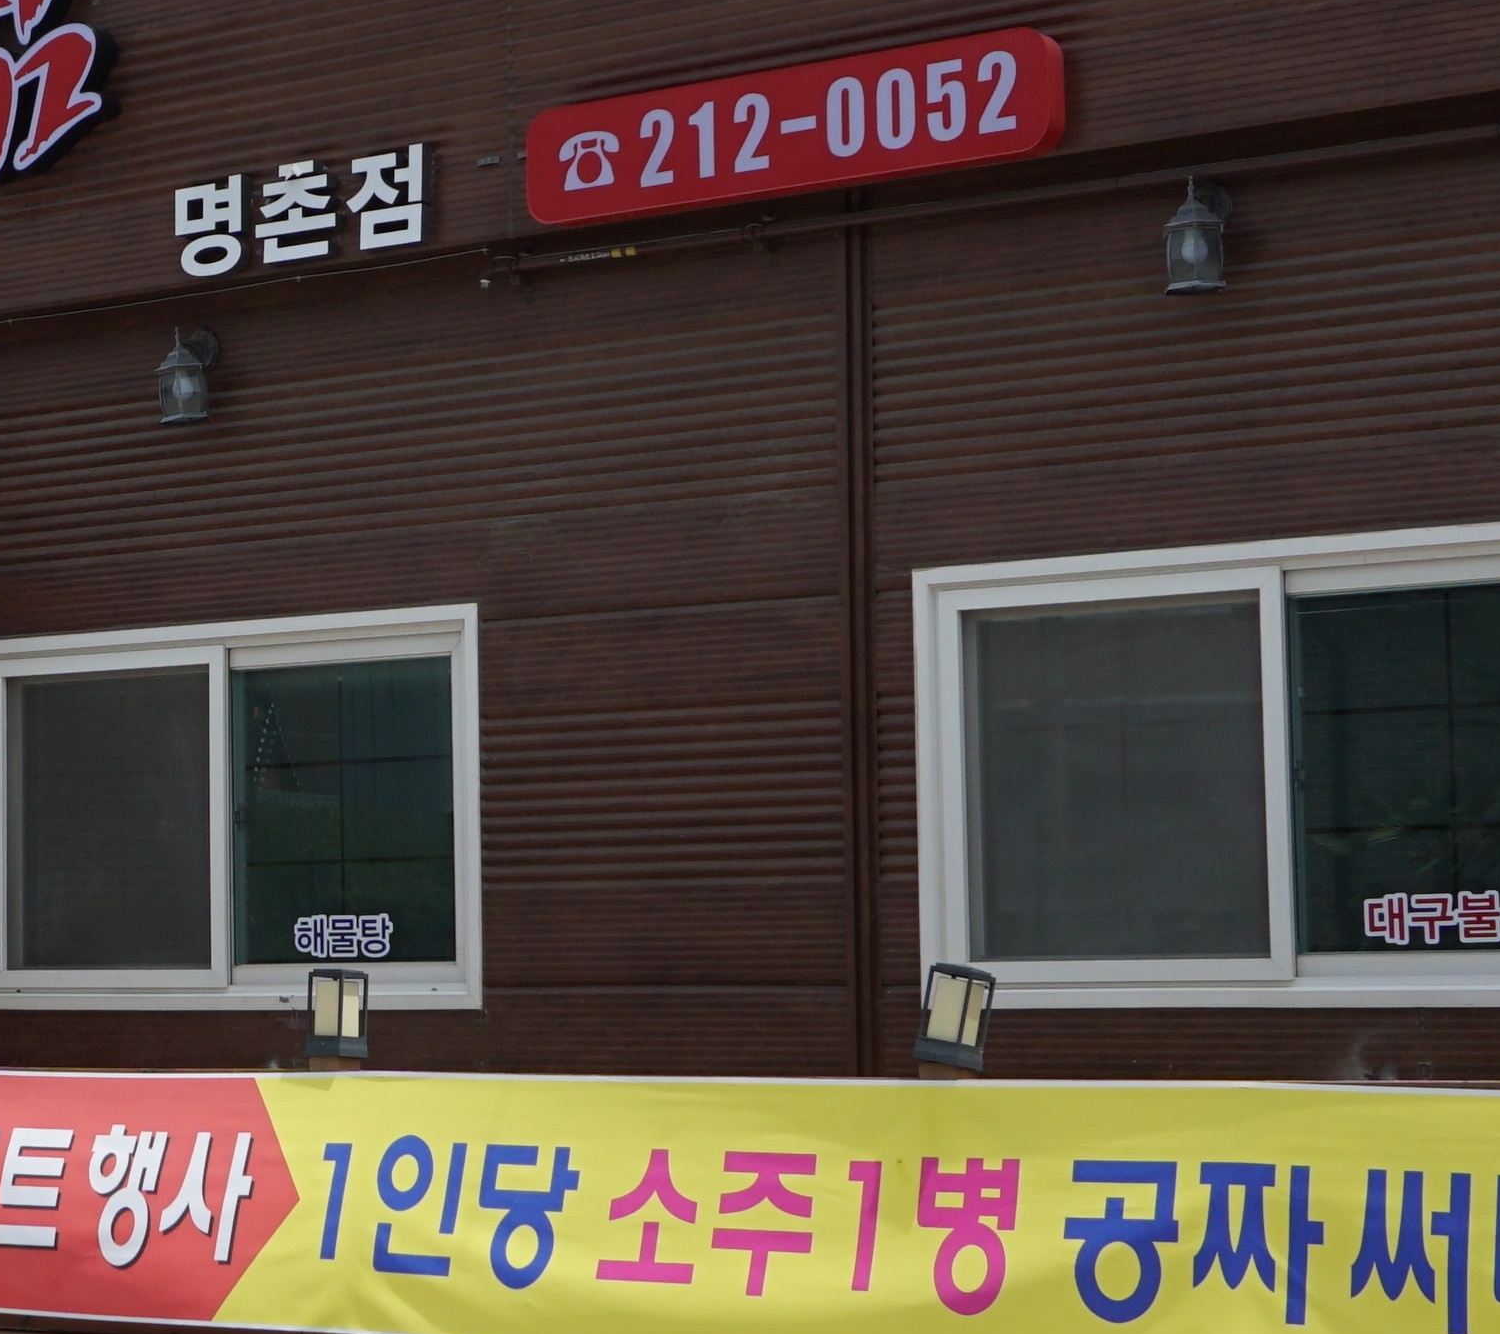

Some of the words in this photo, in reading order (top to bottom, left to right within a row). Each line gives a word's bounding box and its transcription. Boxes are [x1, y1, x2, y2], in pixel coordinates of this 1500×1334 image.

[638, 50, 1018, 190] 212-0052
[173, 142, 426, 278] 명촌점
[292, 910, 395, 960] 해물탕
[87, 1121, 256, 1270] 행사
[319, 1132, 581, 1292] 1인당
[595, 1146, 1021, 1319] 소주1병
